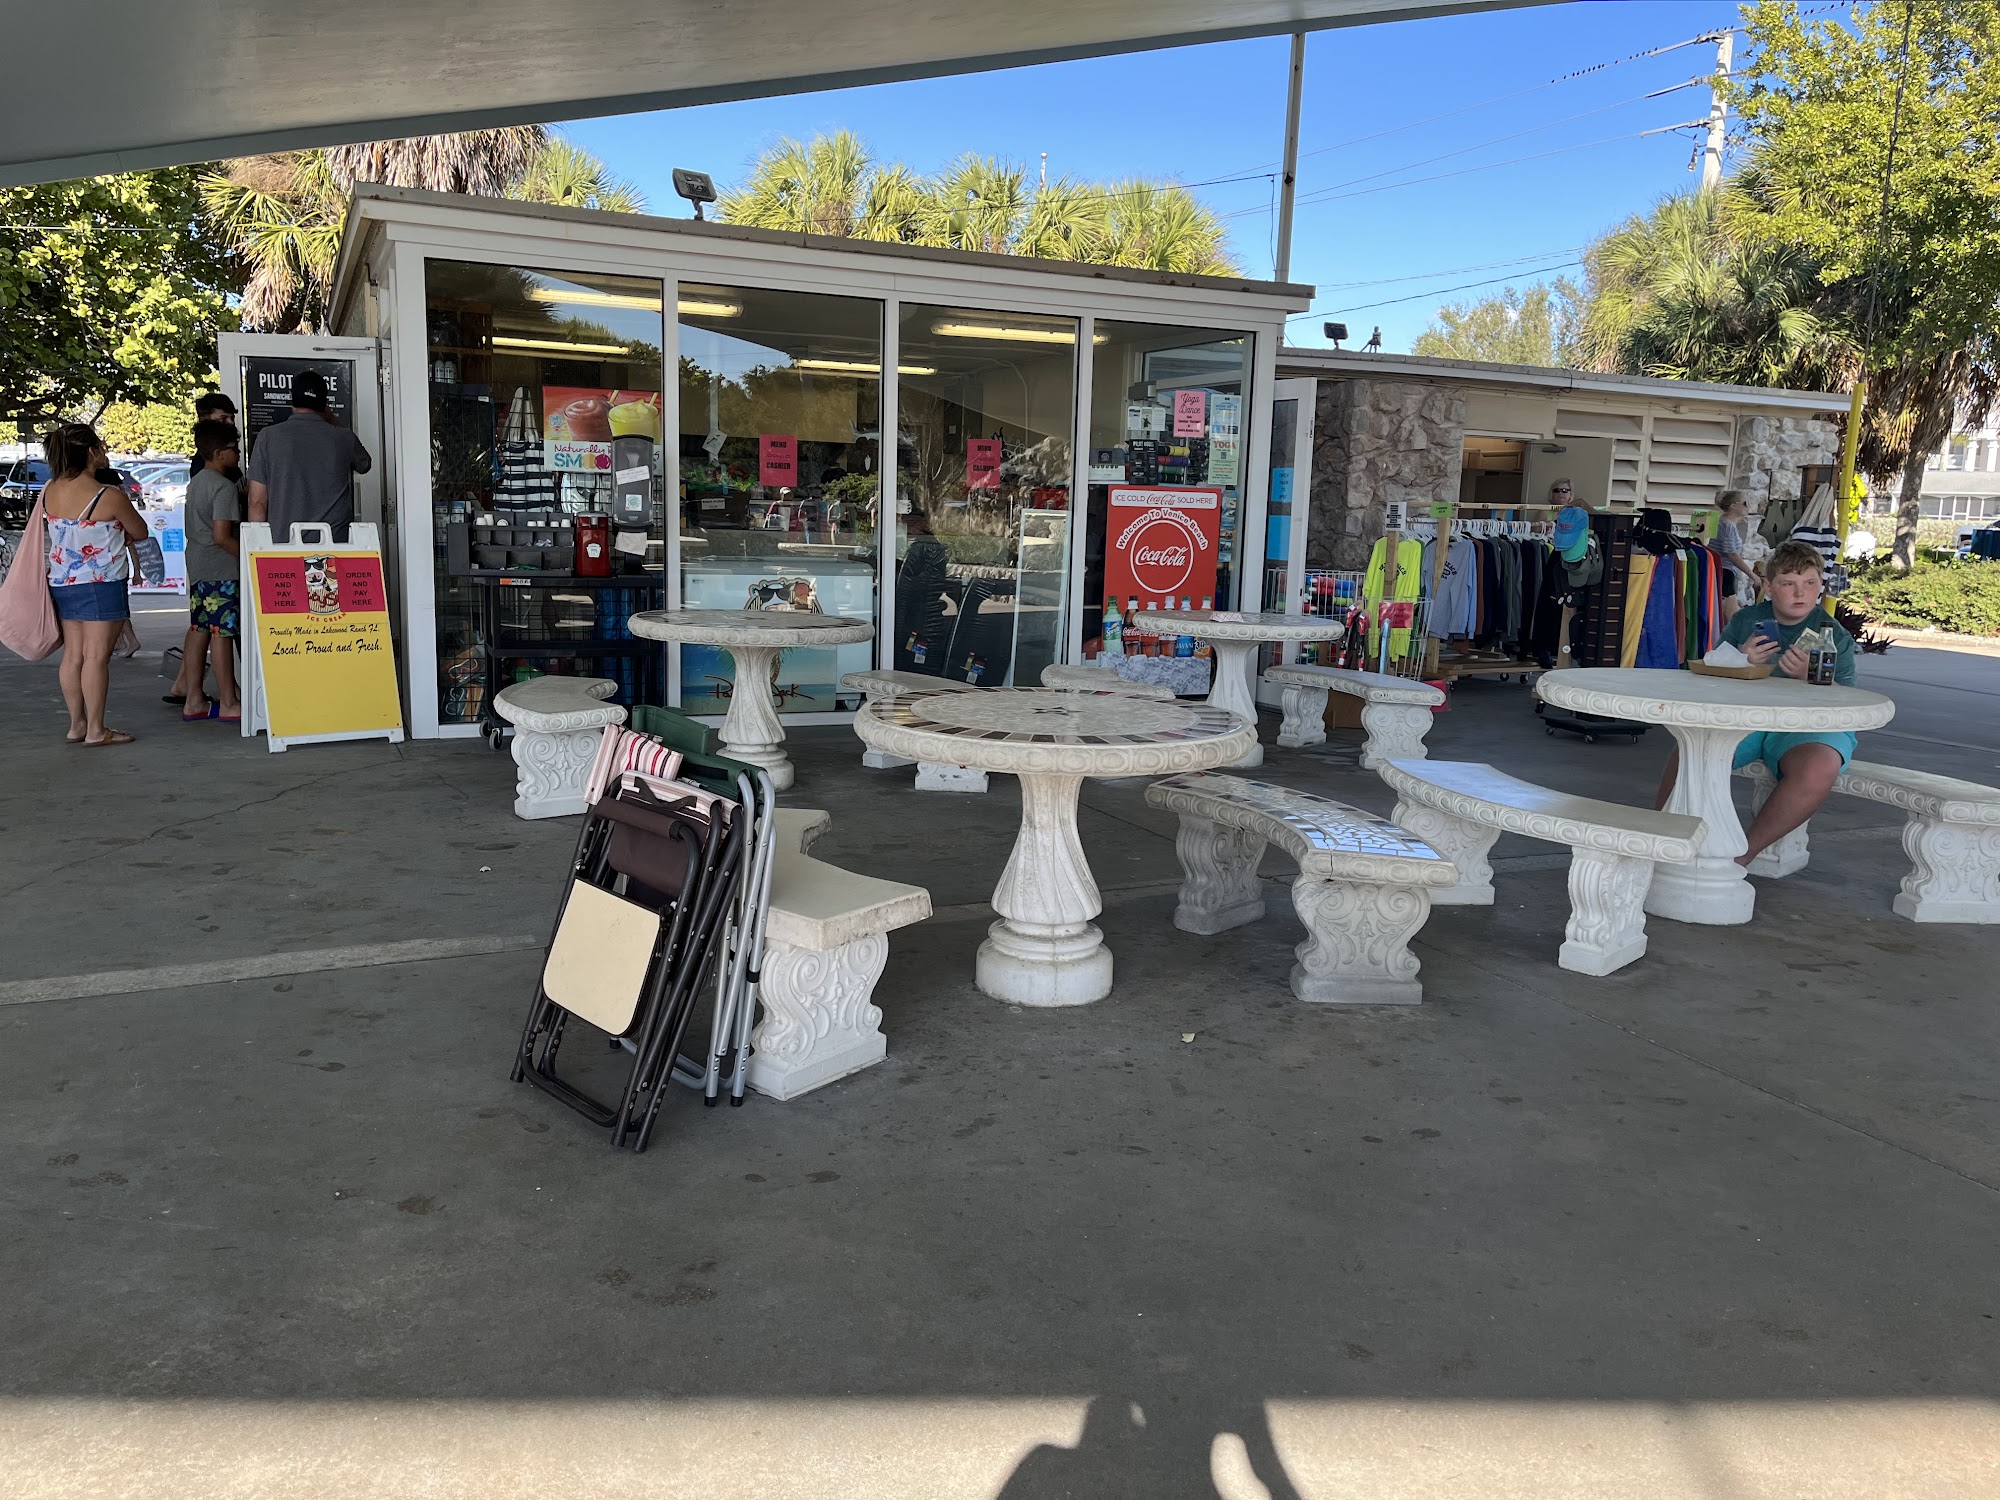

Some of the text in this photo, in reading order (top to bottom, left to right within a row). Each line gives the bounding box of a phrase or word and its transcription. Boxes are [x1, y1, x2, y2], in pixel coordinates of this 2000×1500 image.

[259, 373, 294, 389] PILOT
[1181, 393, 1200, 405] Yoga
[1179, 403, 1201, 414] Dance
[554, 442, 606, 455] Naturally
[1213, 441, 1236, 449] YOGA
[1117, 509, 1208, 549] Welcome To Venice Beach
[269, 627, 293, 636] Proudly
[294, 626, 312, 635] Made
[321, 625, 348, 634] Lakewood
[350, 624, 367, 632] Ranch
[305, 640, 333, 654] Proud
[336, 642, 352, 652] and
[356, 638, 382, 654] Fresh.
